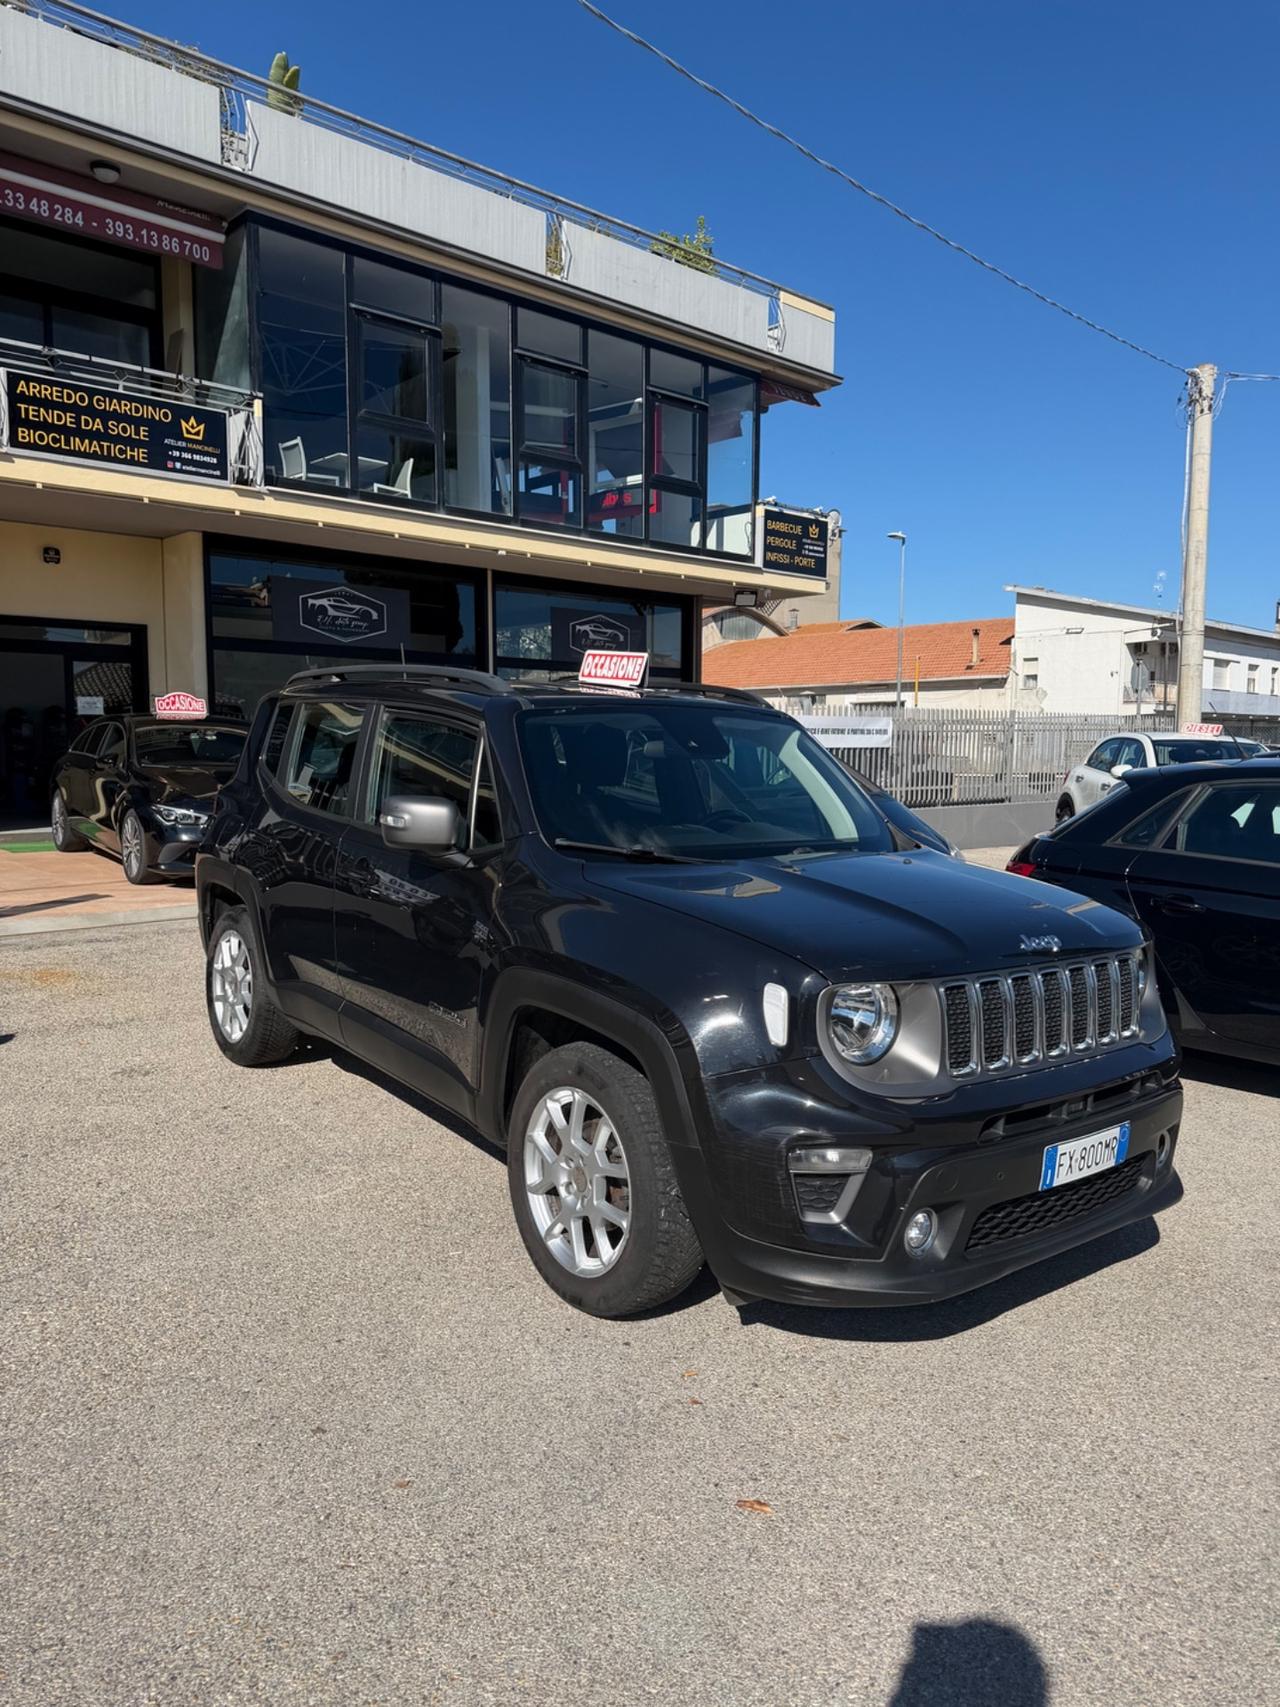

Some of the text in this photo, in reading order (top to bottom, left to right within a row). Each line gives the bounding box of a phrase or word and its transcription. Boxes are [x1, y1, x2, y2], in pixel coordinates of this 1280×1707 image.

[16, 380, 172, 422] ARREDO GIARDINO
[17, 403, 150, 441] TENDE DA SOLE
[17, 427, 149, 463] BIOCLIMATICHE
[164, 438, 187, 448] ATELIER
[766, 520, 803, 535] BARBECUE
[766, 536, 797, 550] PERGOLE
[766, 552, 790, 564] INFISSI
[794, 556, 816, 568] PORTE
[582, 654, 643, 679] OCCASIONE
[158, 696, 205, 711] OCCASIONE
[1184, 723, 1221, 735] DIESEL
[1019, 934, 1063, 952] Jeep
